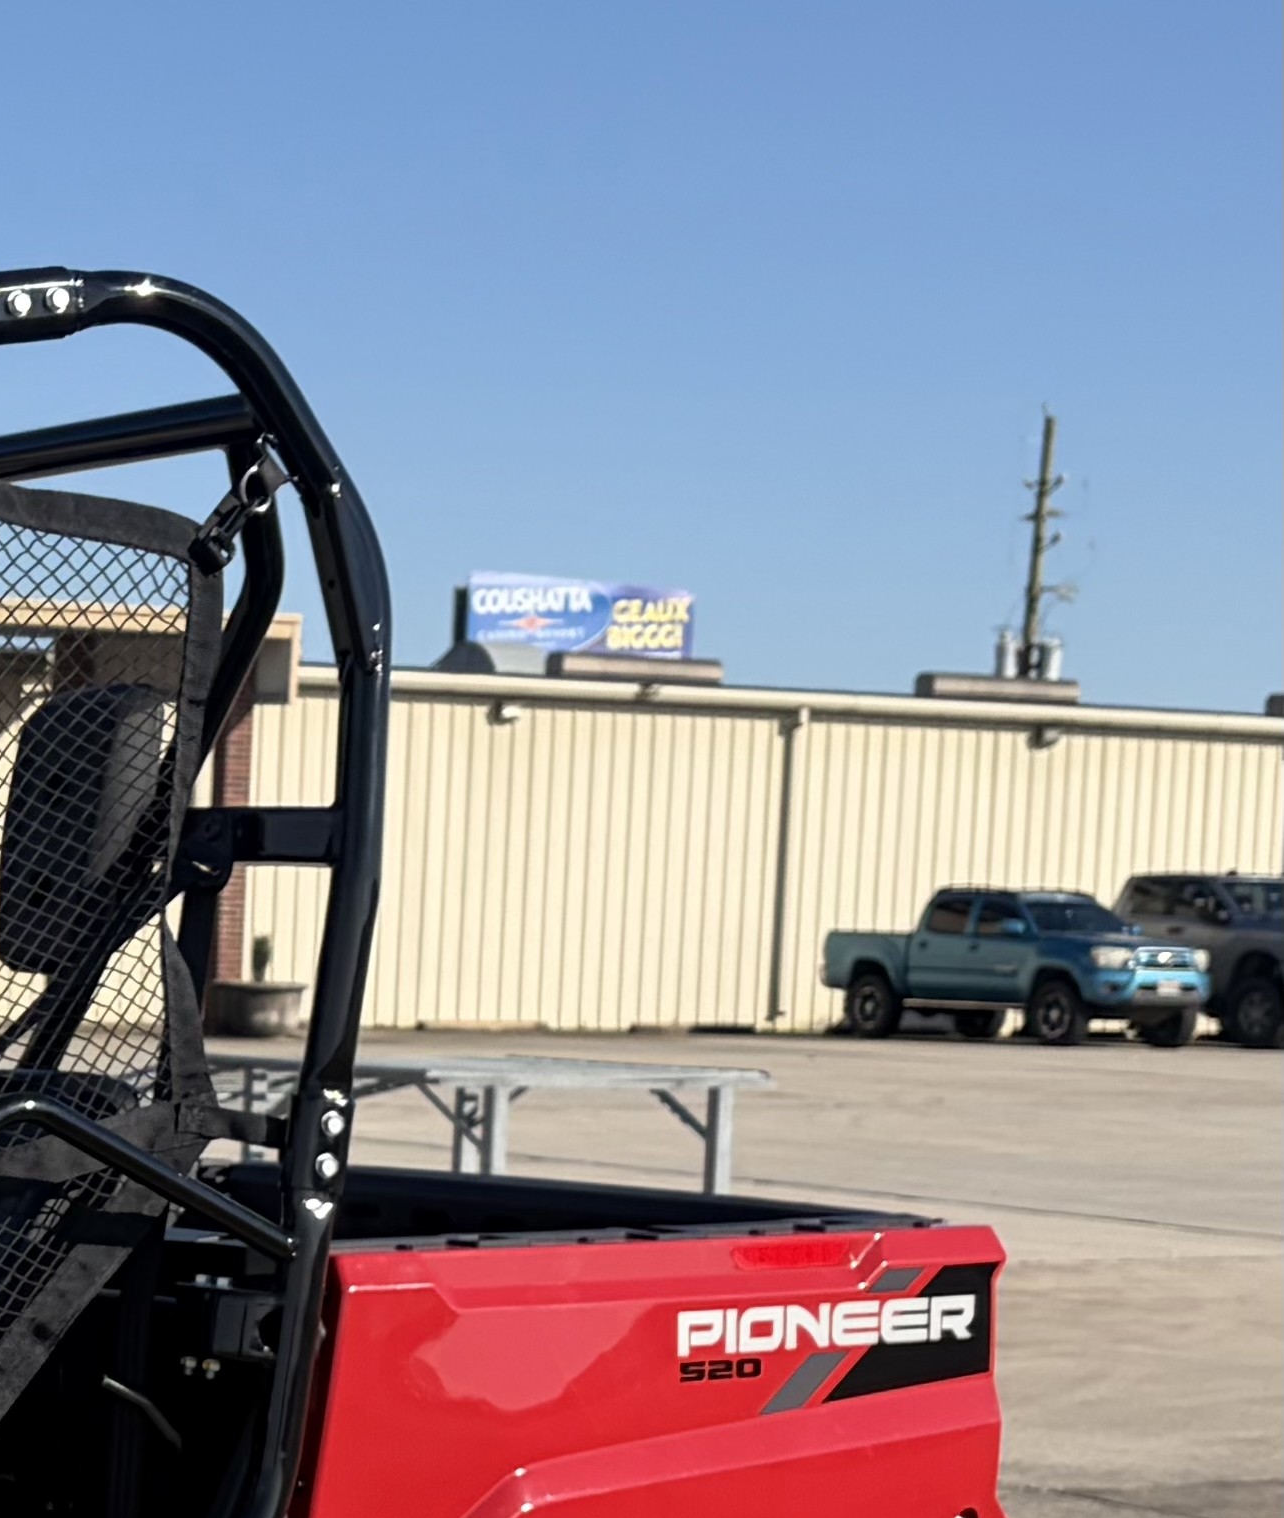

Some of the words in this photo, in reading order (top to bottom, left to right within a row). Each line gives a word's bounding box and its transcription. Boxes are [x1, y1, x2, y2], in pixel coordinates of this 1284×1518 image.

[473, 587, 592, 614] COUSHATTA
[677, 1294, 976, 1357] PIONEER
[679, 1358, 762, 1382] 520
